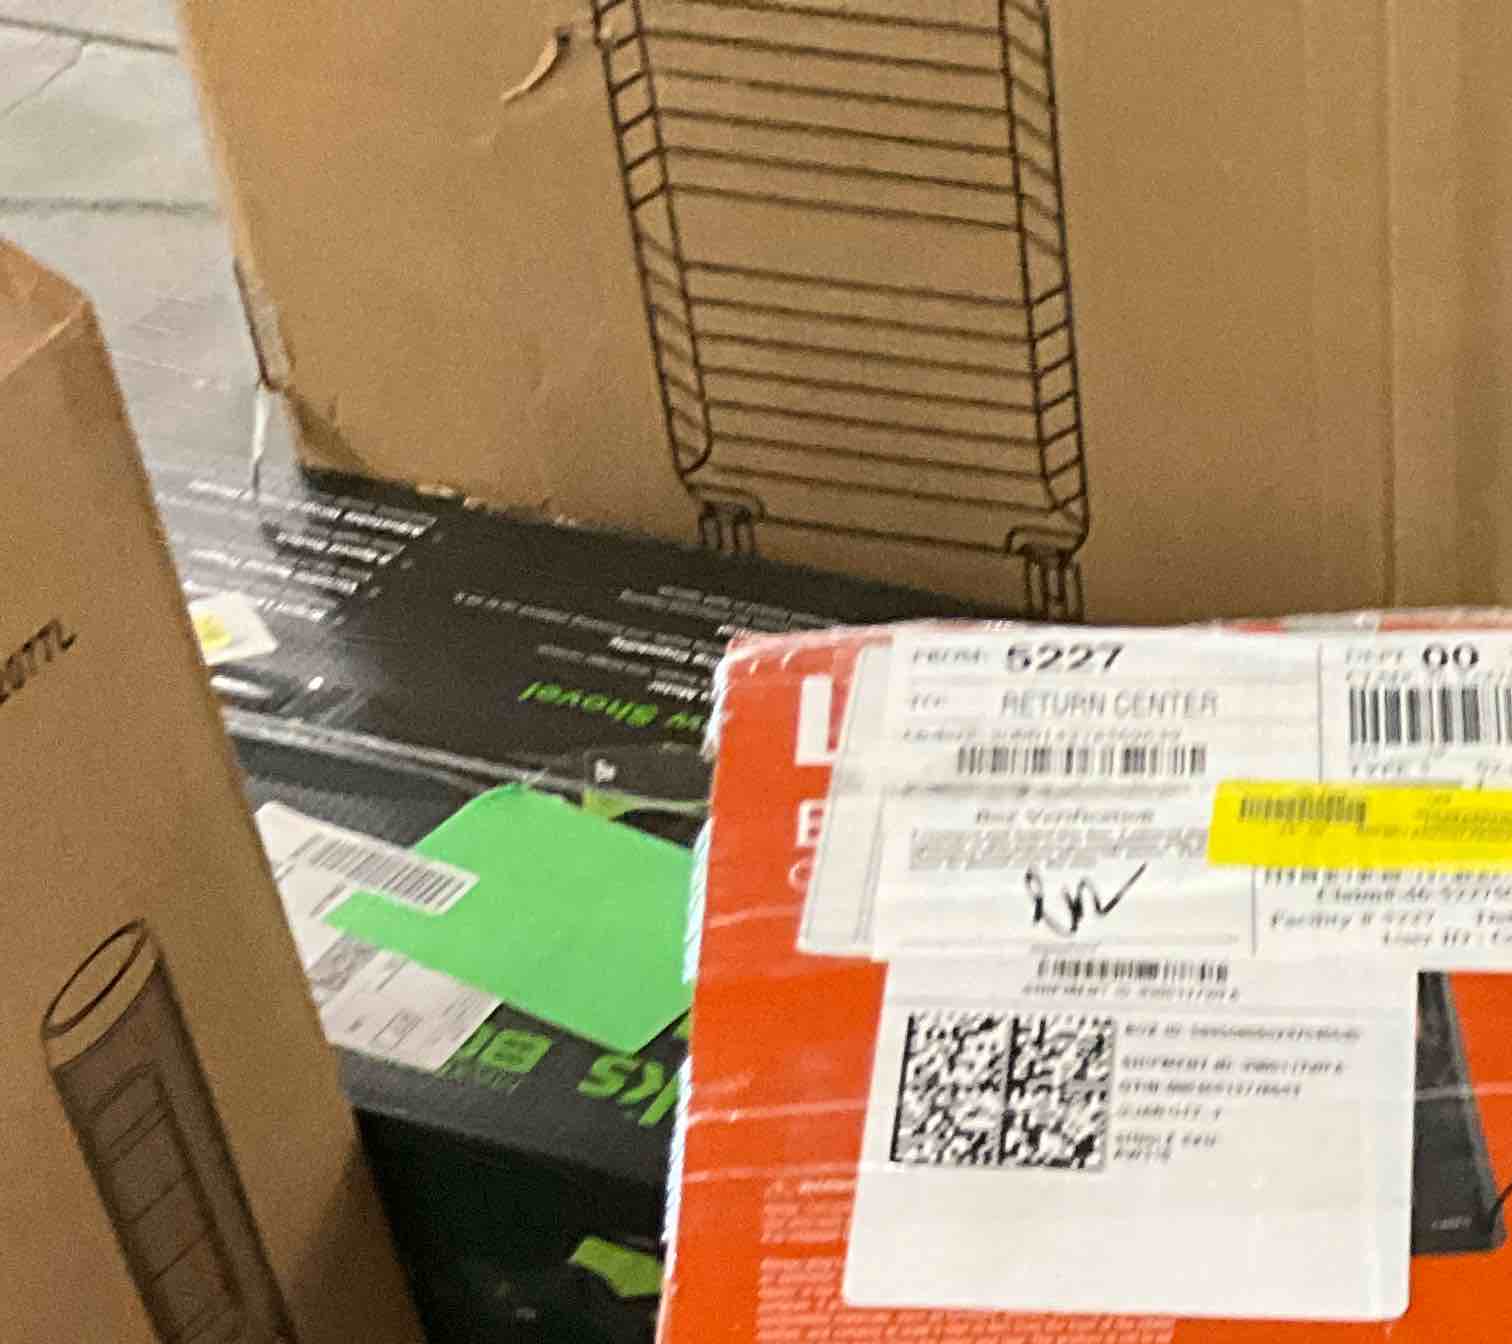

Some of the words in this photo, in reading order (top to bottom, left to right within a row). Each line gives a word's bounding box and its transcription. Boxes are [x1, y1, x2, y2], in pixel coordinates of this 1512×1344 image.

[1006, 641, 1126, 672] 5227
[1001, 688, 1106, 716] RETURN
[1113, 688, 1218, 717] CENTER
